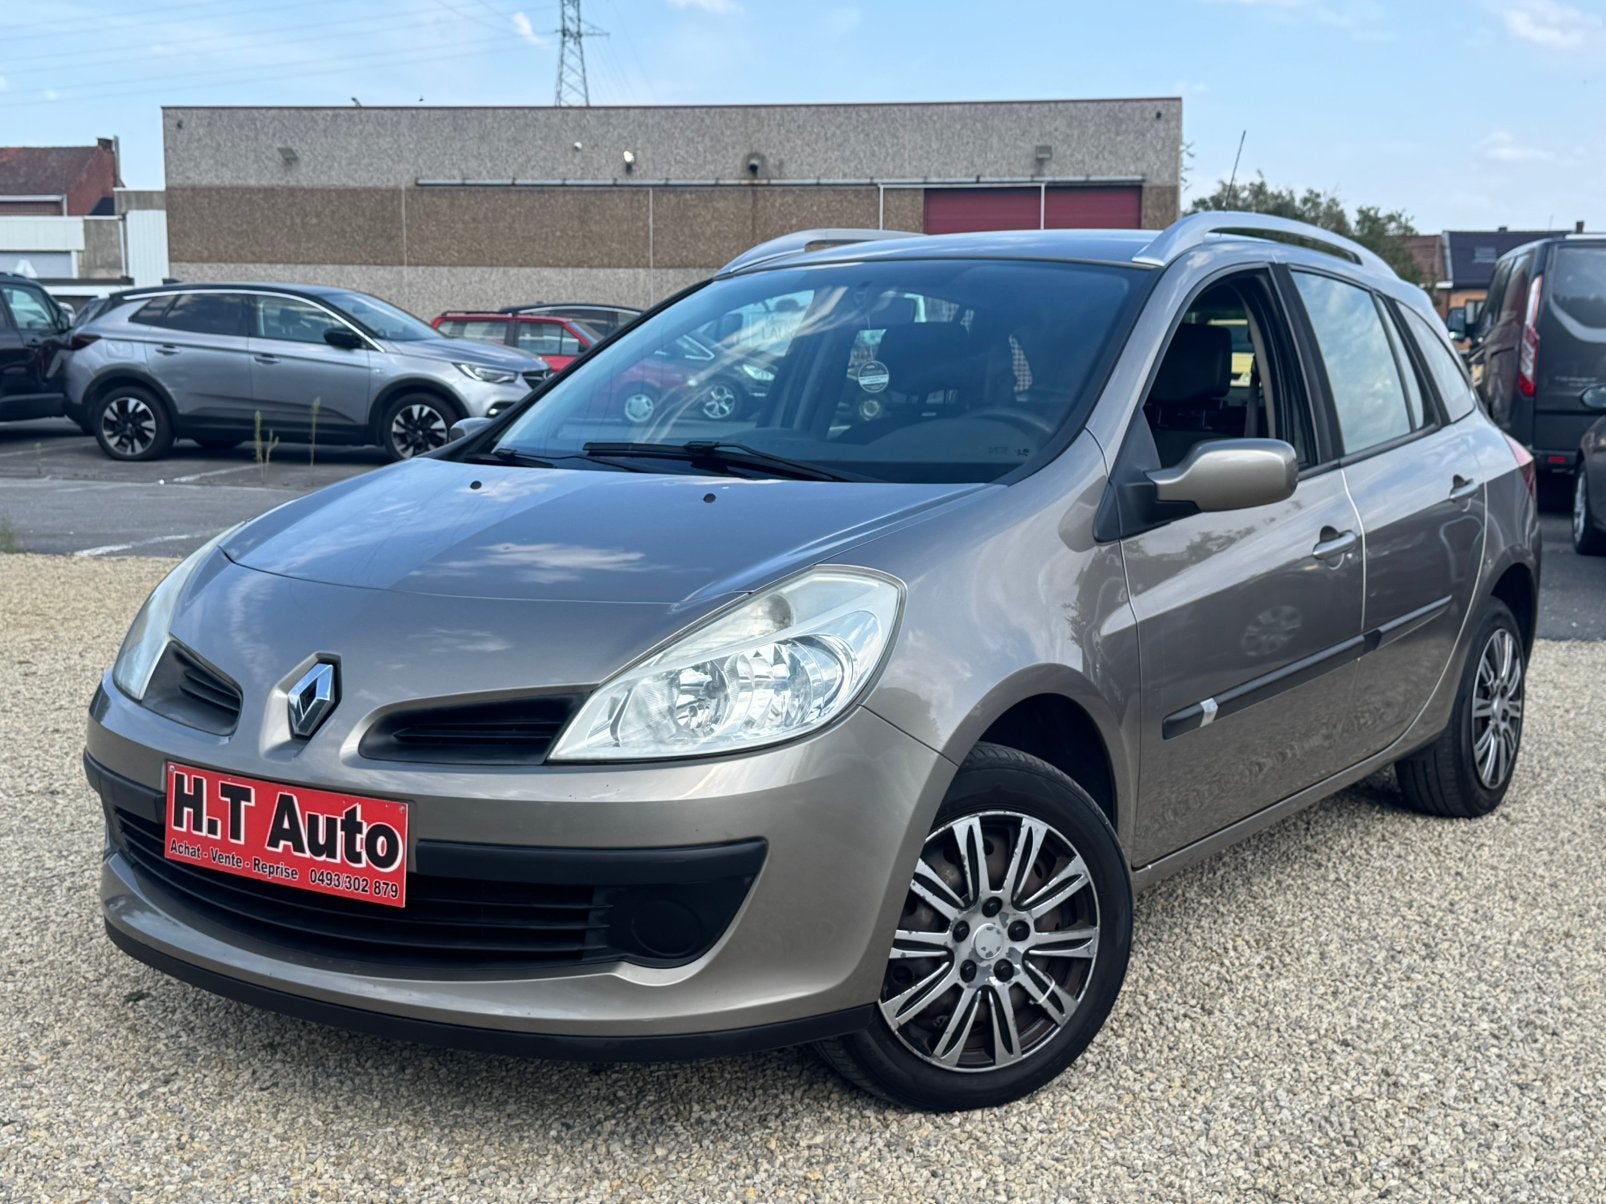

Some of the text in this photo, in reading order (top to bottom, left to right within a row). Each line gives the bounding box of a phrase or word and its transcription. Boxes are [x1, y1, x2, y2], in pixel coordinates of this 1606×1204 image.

[173, 771, 404, 873] H.T Auto
[170, 838, 201, 859] Achat
[210, 847, 243, 868] Vente
[253, 856, 299, 880] Reprise
[309, 867, 370, 895] 0493/302
[373, 880, 399, 899] 879
